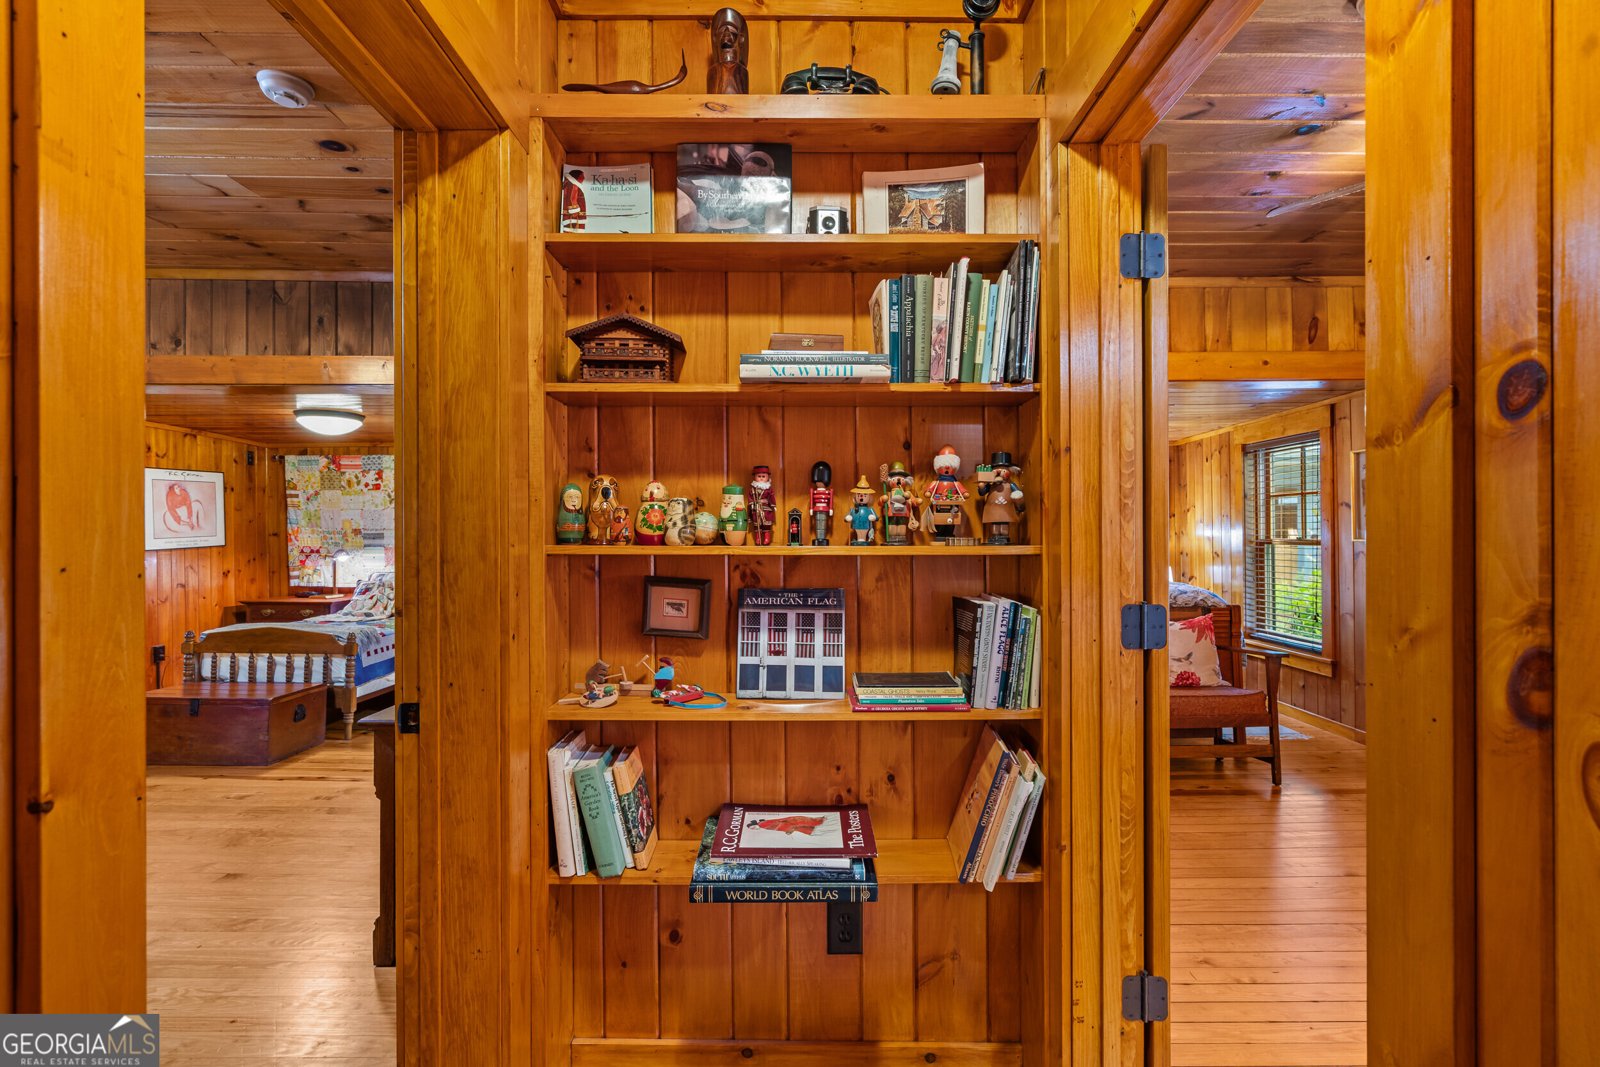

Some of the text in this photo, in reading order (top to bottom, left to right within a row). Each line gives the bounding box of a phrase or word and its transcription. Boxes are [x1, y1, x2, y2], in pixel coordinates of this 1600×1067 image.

[697, 190, 708, 200] By
[904, 294, 914, 337] Appalachia
[769, 365, 854, 377] N.C. WYETH
[1000, 606, 1009, 628] ALICE
[982, 638, 991, 653] GHOST
[998, 630, 1007, 655] FLAGG
[981, 653, 990, 673] STORIES
[994, 666, 1002, 684] RHYNE
[979, 787, 998, 827] PINOCCHIO
[848, 810, 862, 833] Posters
[848, 834, 864, 849] The
[726, 889, 839, 900] WORLD BOOK ATLAS
